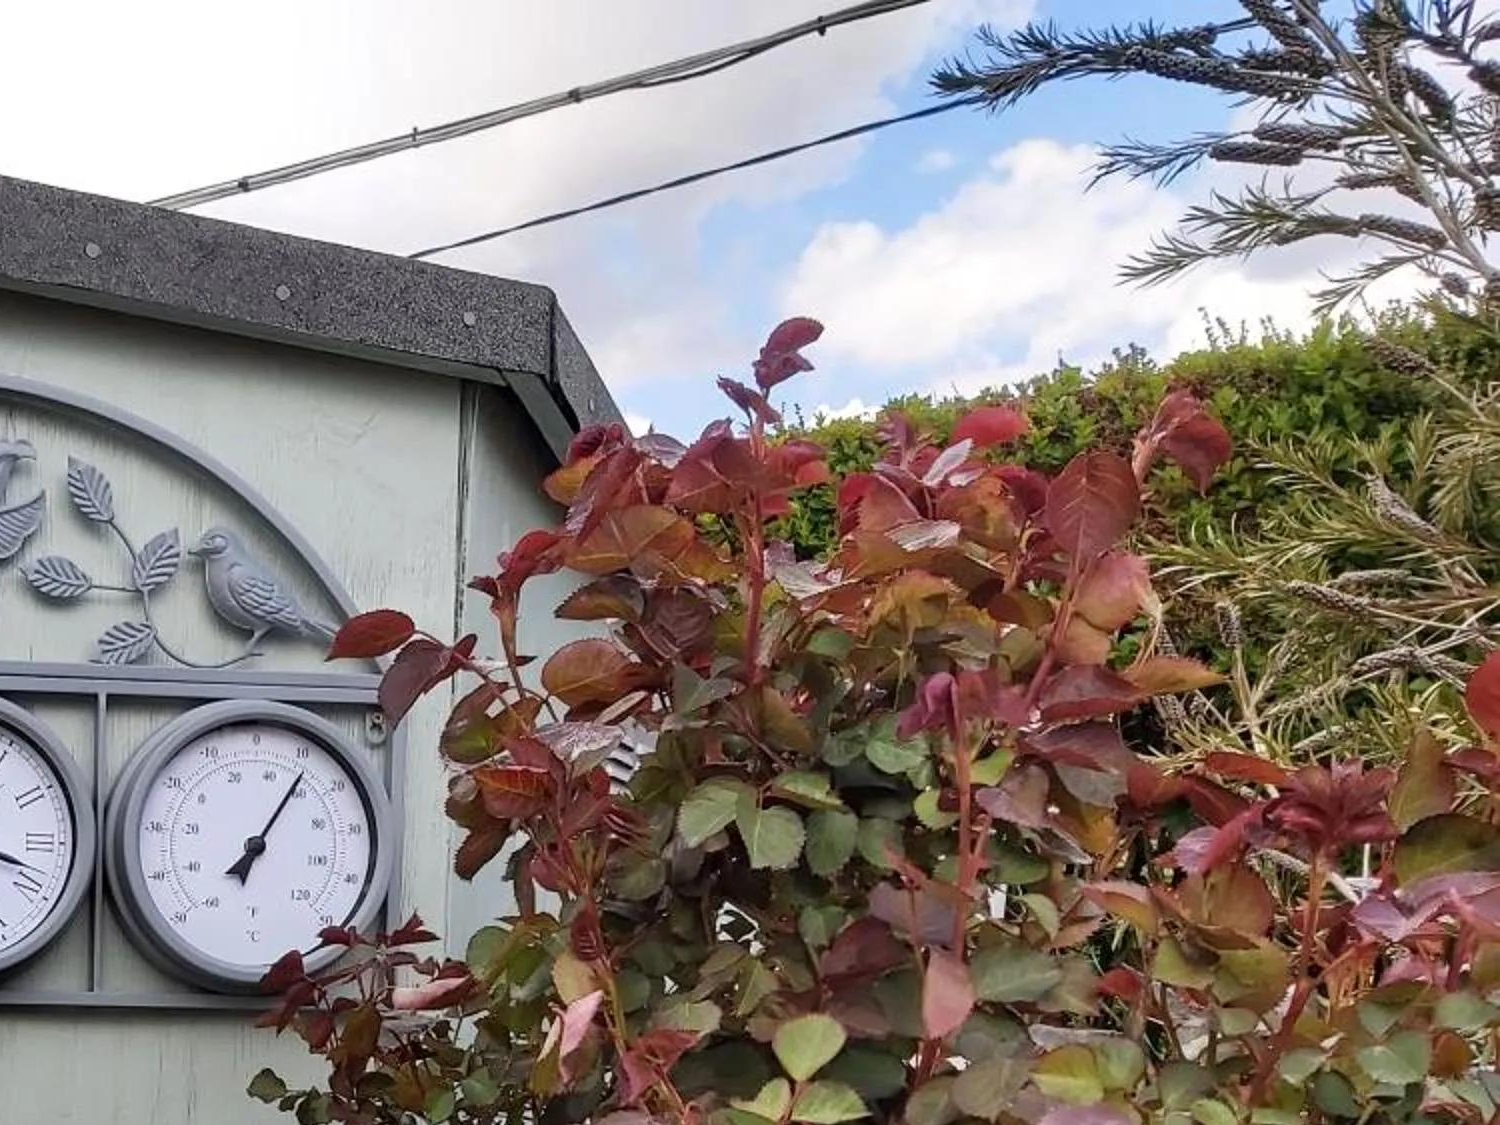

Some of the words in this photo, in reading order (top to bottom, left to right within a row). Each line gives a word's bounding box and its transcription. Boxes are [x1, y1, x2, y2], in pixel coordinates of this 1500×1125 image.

[252, 734, 261, 746] 0
[296, 747, 309, 759] 10
[227, 771, 242, 783] 20
[262, 771, 276, 782] 40
[330, 780, 345, 792] 20
[311, 818, 326, 831] 80
[308, 855, 327, 866] 100
[344, 873, 358, 885] 40
[291, 889, 310, 901] 120
[319, 915, 333, 926] 50
